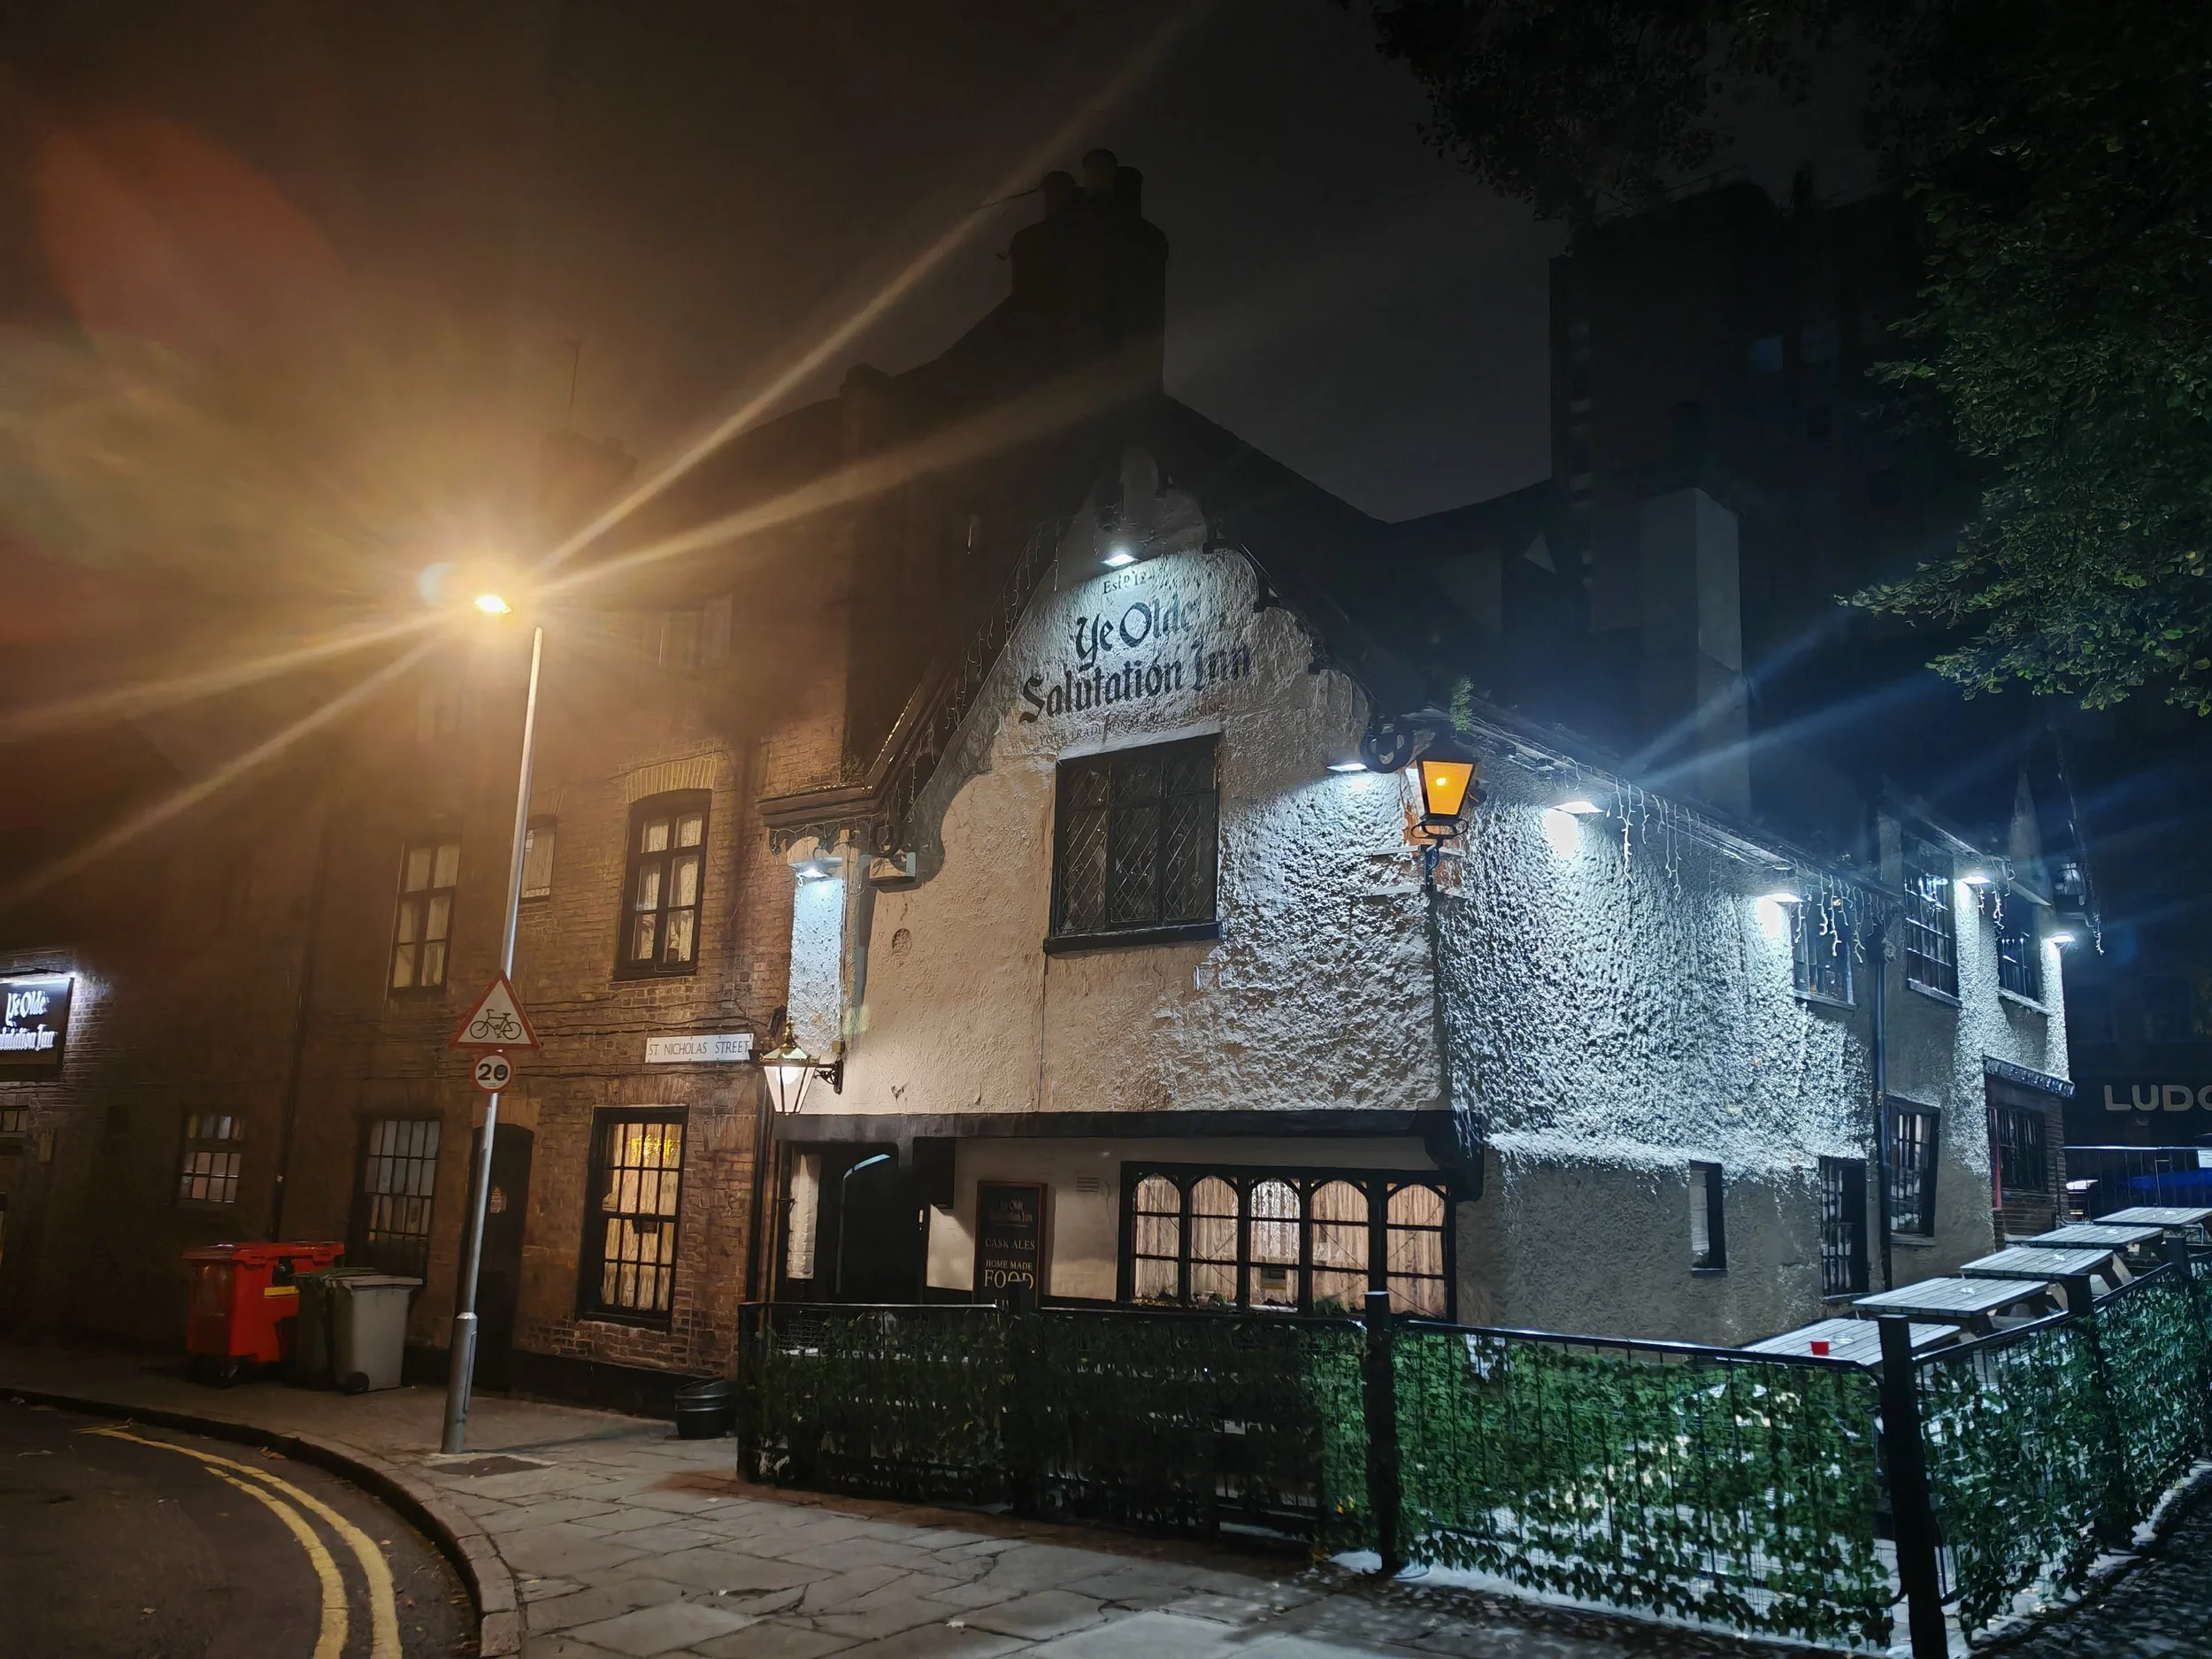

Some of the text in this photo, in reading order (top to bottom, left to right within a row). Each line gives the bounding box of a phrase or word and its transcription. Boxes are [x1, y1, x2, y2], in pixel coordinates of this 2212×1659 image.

[1076, 593, 1196, 672] Ye Olde
[1019, 635, 1250, 724] Salutation Inn
[649, 1041, 749, 1056] ST NICHOLAS STREET
[478, 1063, 508, 1081] 20
[985, 1239, 1035, 1250] CASK ALES
[986, 1258, 1033, 1271] HOME MADE
